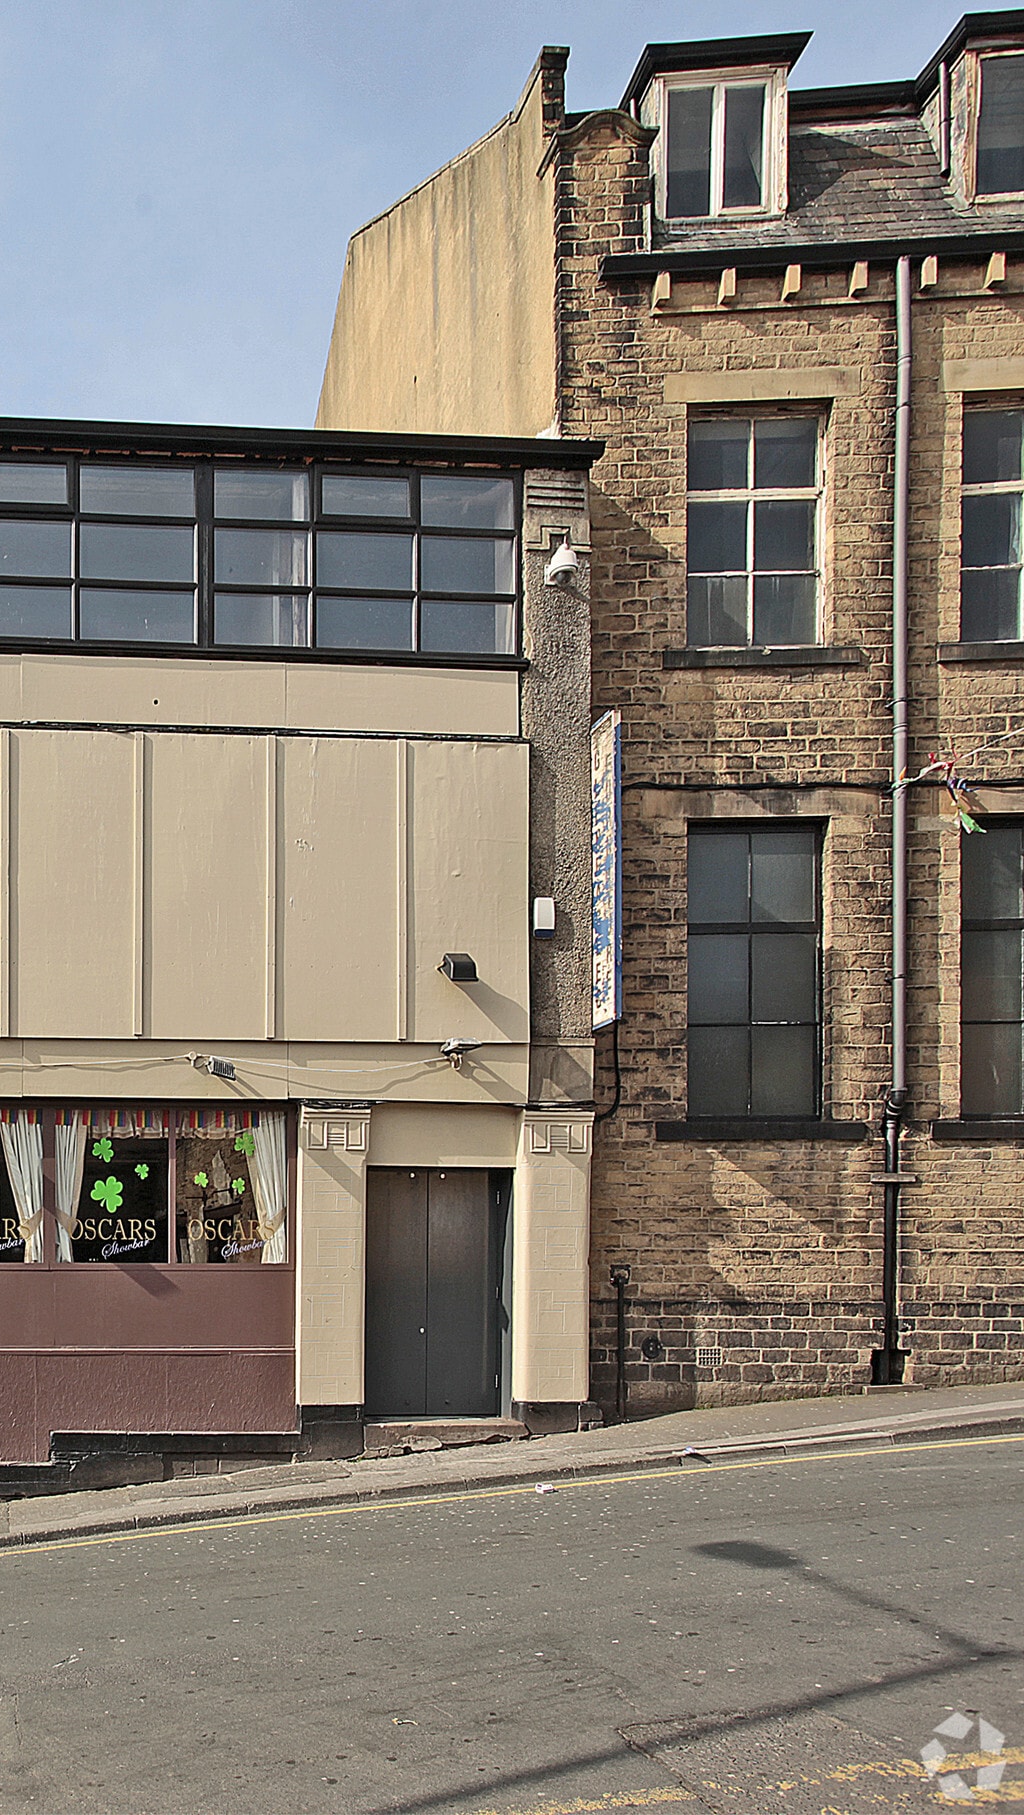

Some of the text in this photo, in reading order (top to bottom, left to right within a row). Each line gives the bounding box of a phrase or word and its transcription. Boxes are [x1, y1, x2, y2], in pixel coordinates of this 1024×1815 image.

[70, 1218, 157, 1241] OSCARS
[188, 1218, 277, 1242] OSCARS
[101, 1238, 150, 1260] Showbar
